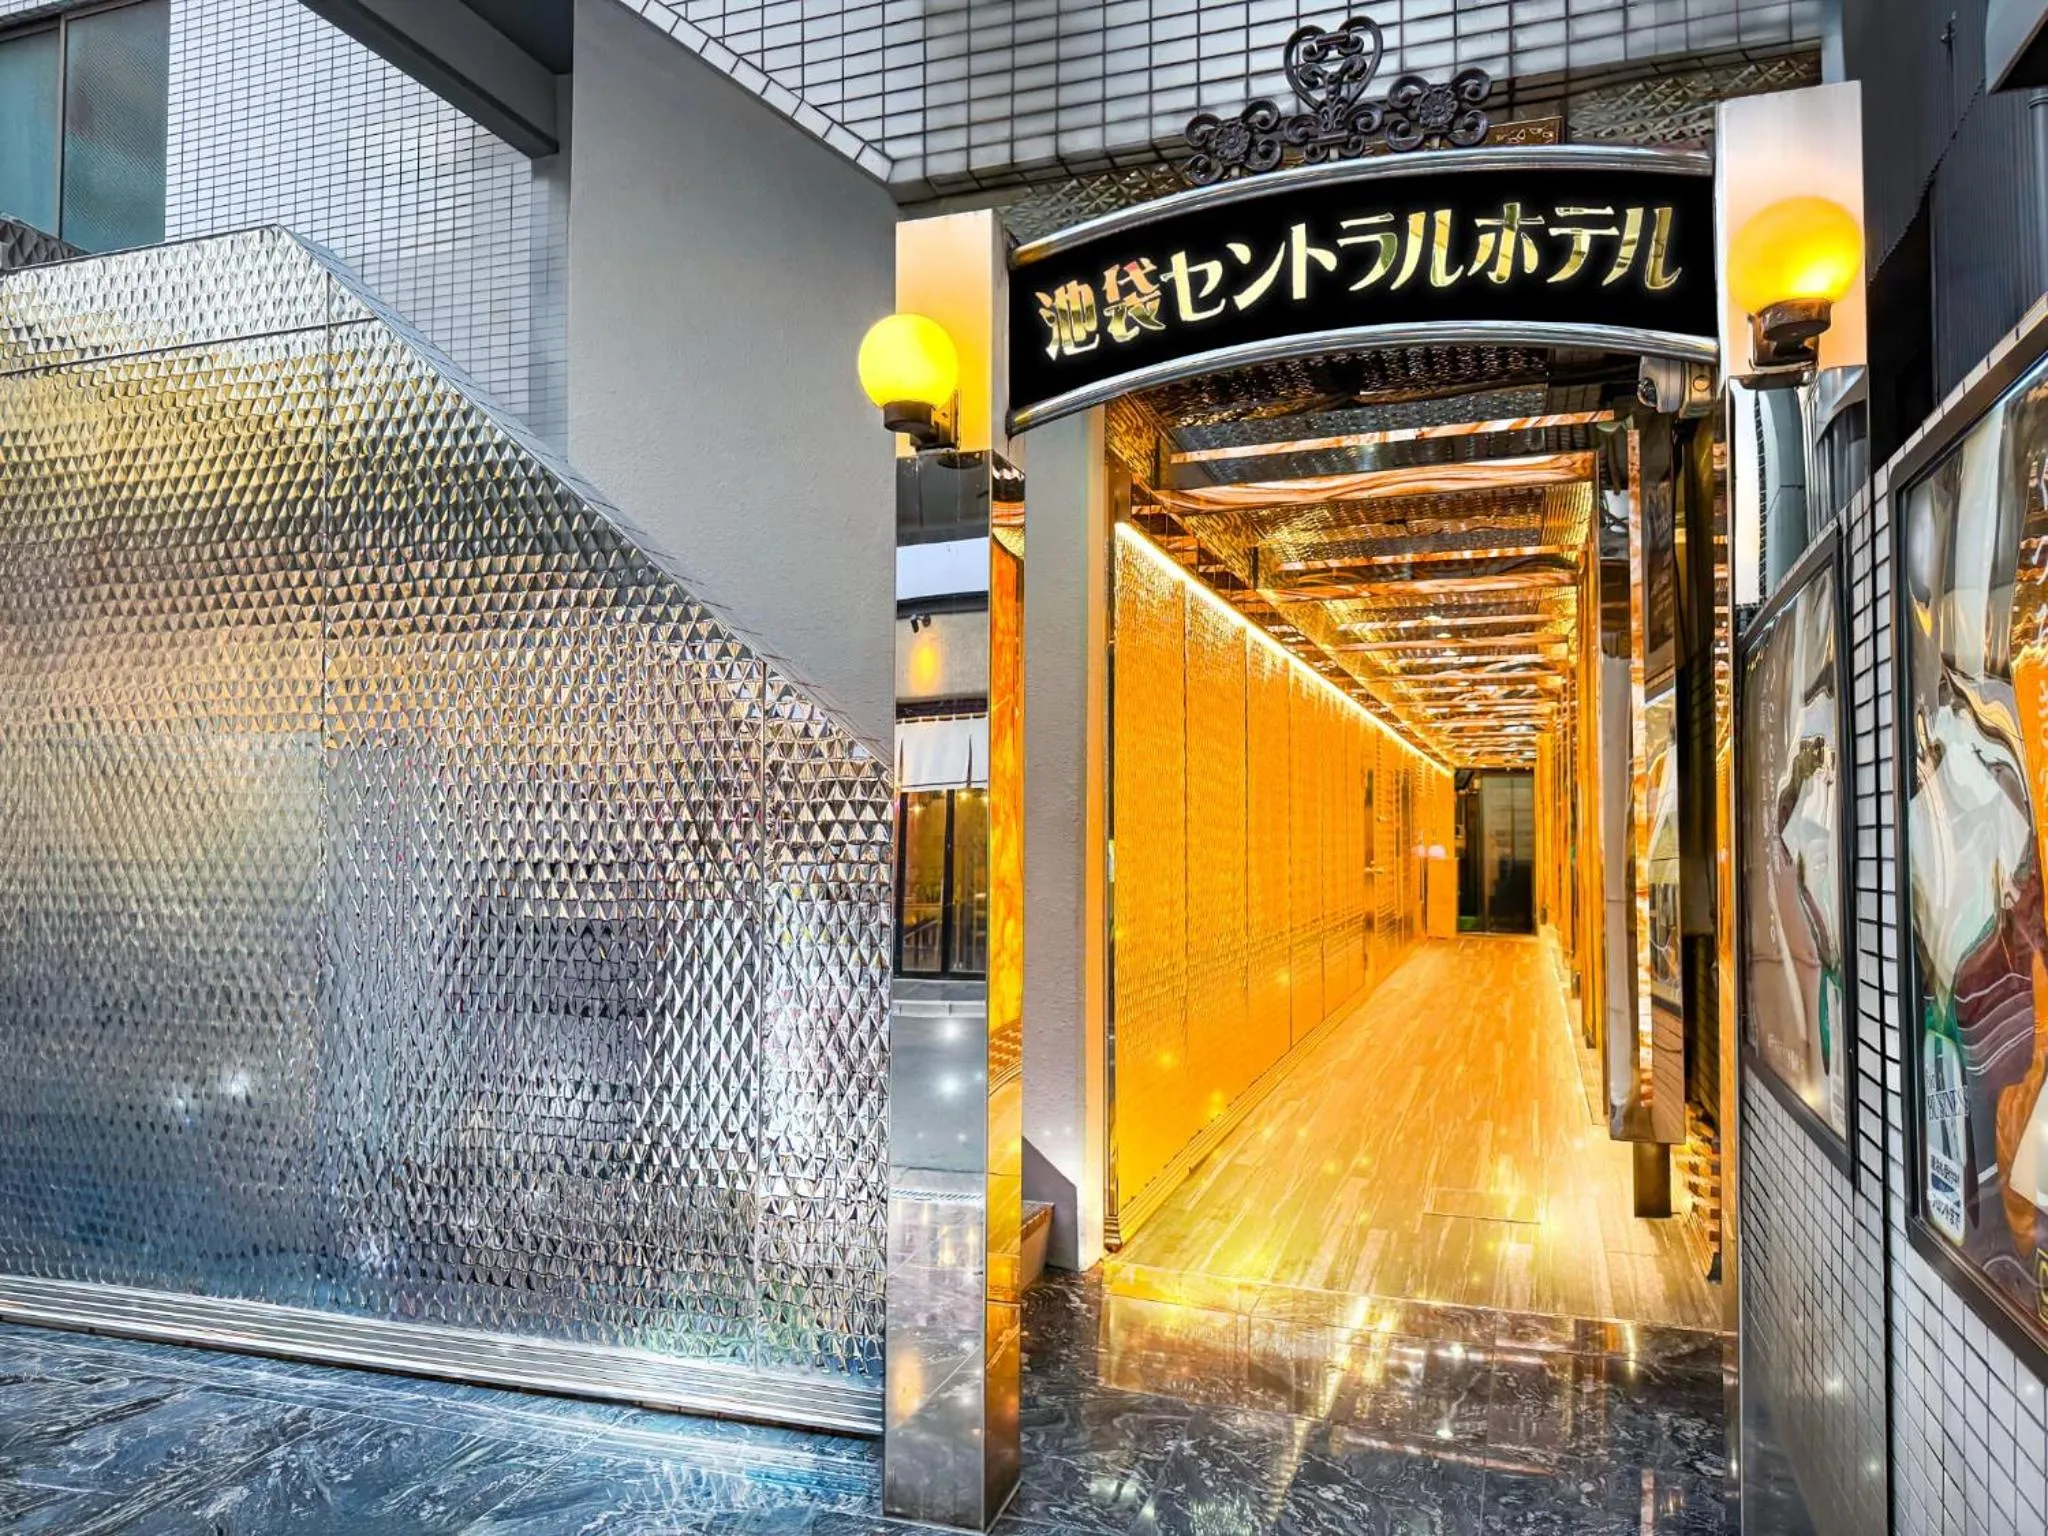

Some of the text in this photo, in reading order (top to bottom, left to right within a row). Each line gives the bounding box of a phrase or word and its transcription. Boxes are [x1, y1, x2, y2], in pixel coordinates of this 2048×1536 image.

[1034, 202, 1683, 361] 池袋セントラルホテル
